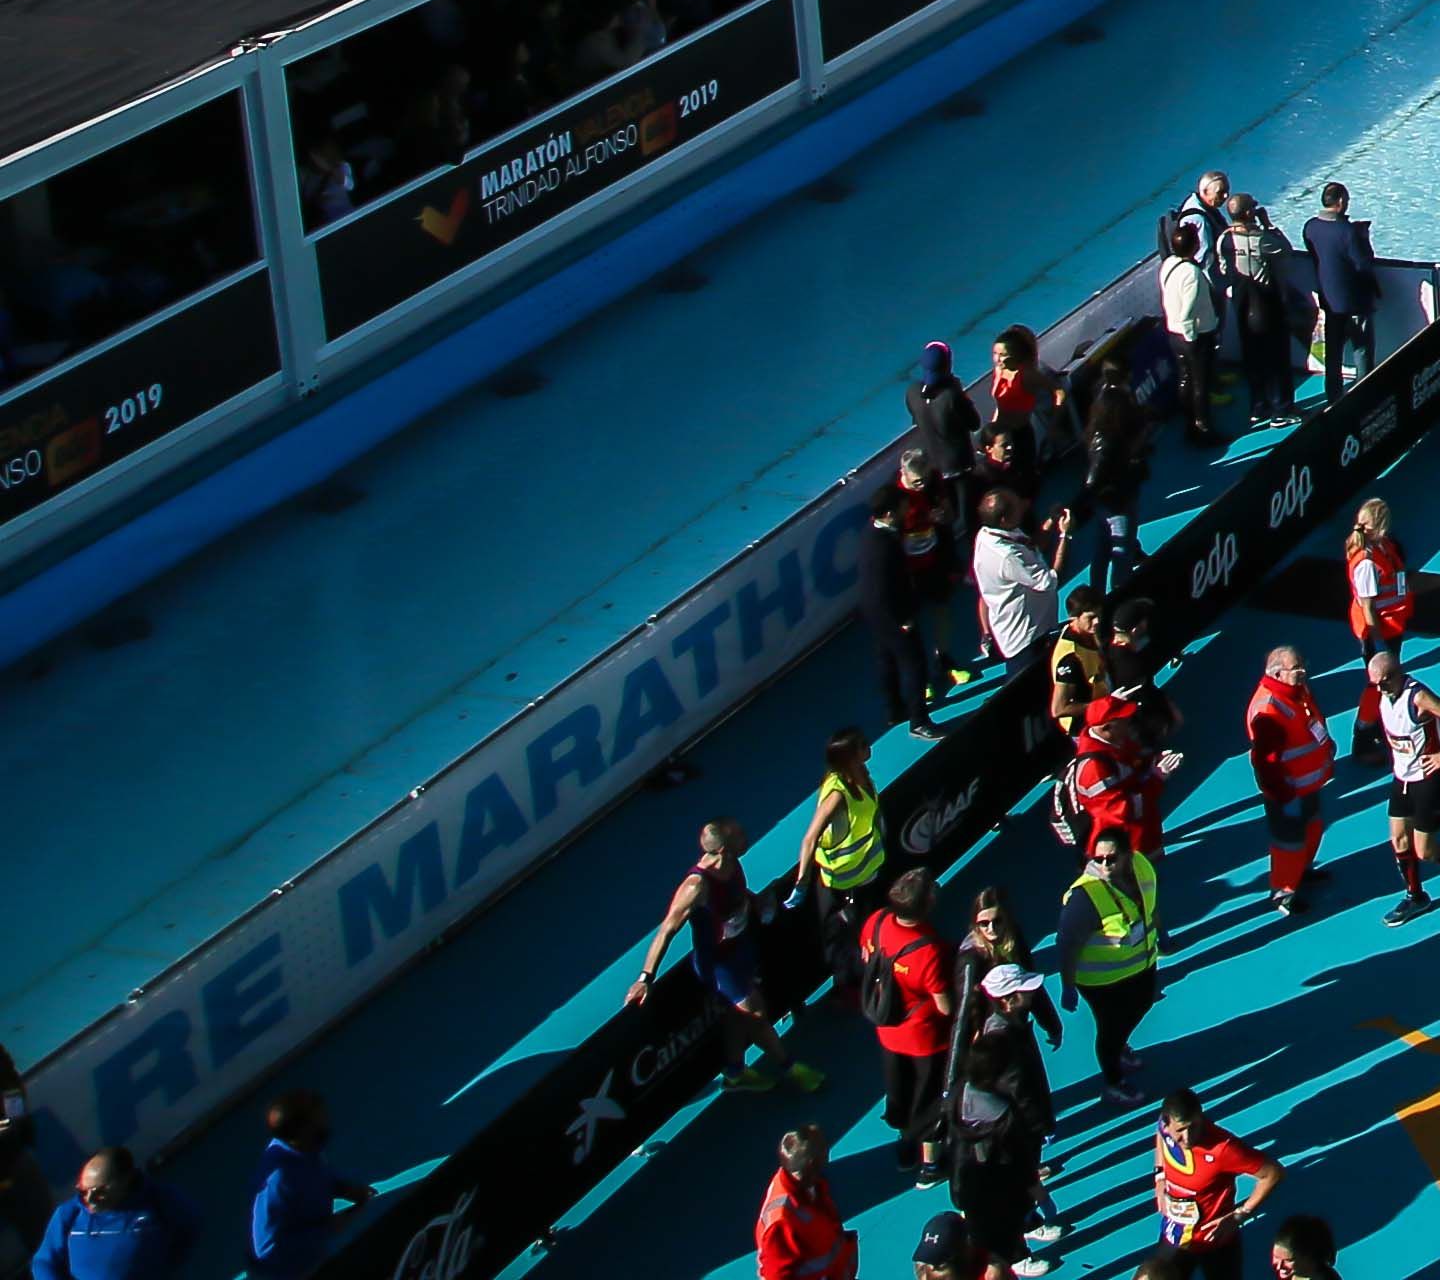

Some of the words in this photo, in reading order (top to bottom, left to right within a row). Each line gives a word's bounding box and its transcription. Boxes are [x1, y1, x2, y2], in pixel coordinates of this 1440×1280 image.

[480, 129, 572, 201] MARATÓN
[482, 169, 562, 227] TRINIDAD
[563, 123, 639, 191] ALFONSO
[679, 78, 719, 119] 2019
[105, 381, 165, 436] 2019
[1269, 465, 1314, 529] edp
[1191, 533, 1239, 599] edp
